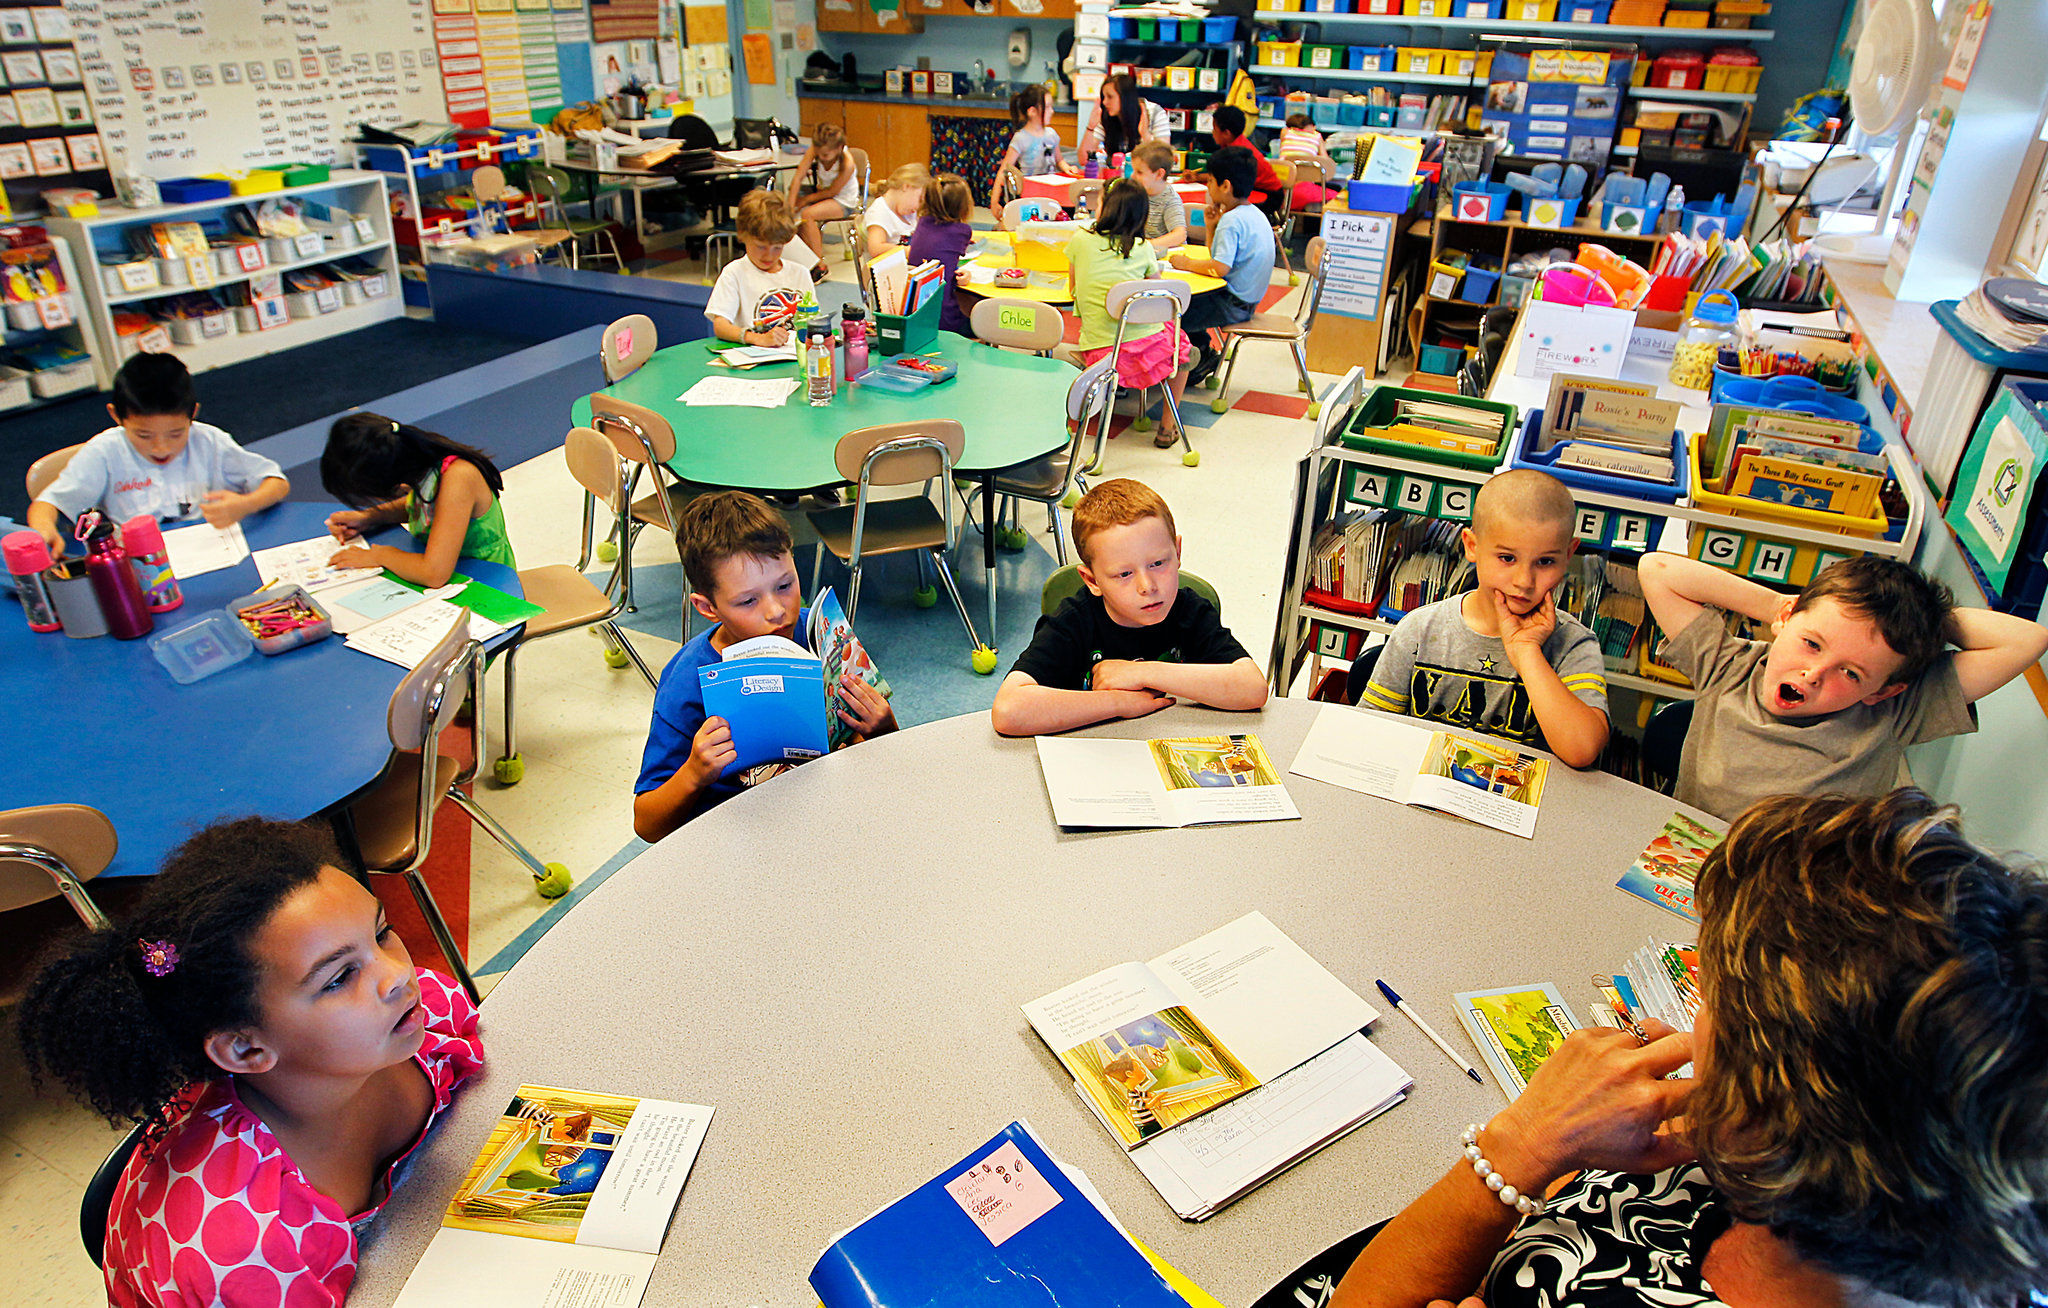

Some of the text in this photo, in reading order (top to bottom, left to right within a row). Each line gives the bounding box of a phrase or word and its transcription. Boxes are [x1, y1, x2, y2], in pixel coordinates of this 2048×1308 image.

[1330, 219, 1364, 233] I Pick
[1000, 309, 1032, 327] Chloe
[1630, 336, 1676, 351] FIREW
[1594, 401, 1668, 424] Rosie's Party
[1575, 454, 1602, 467] Katie's
[1747, 462, 1846, 489] The Three Billy Goats Gruff
[1359, 477, 1466, 511] A B C
[1580, 513, 1639, 541] E F
[1975, 497, 2006, 543] Assessments
[1708, 536, 1784, 572] G H
[1325, 633, 1337, 651] J
[745, 678, 779, 687] Literacy
[753, 684, 783, 692] Design
[1658, 897, 1698, 917] On the
